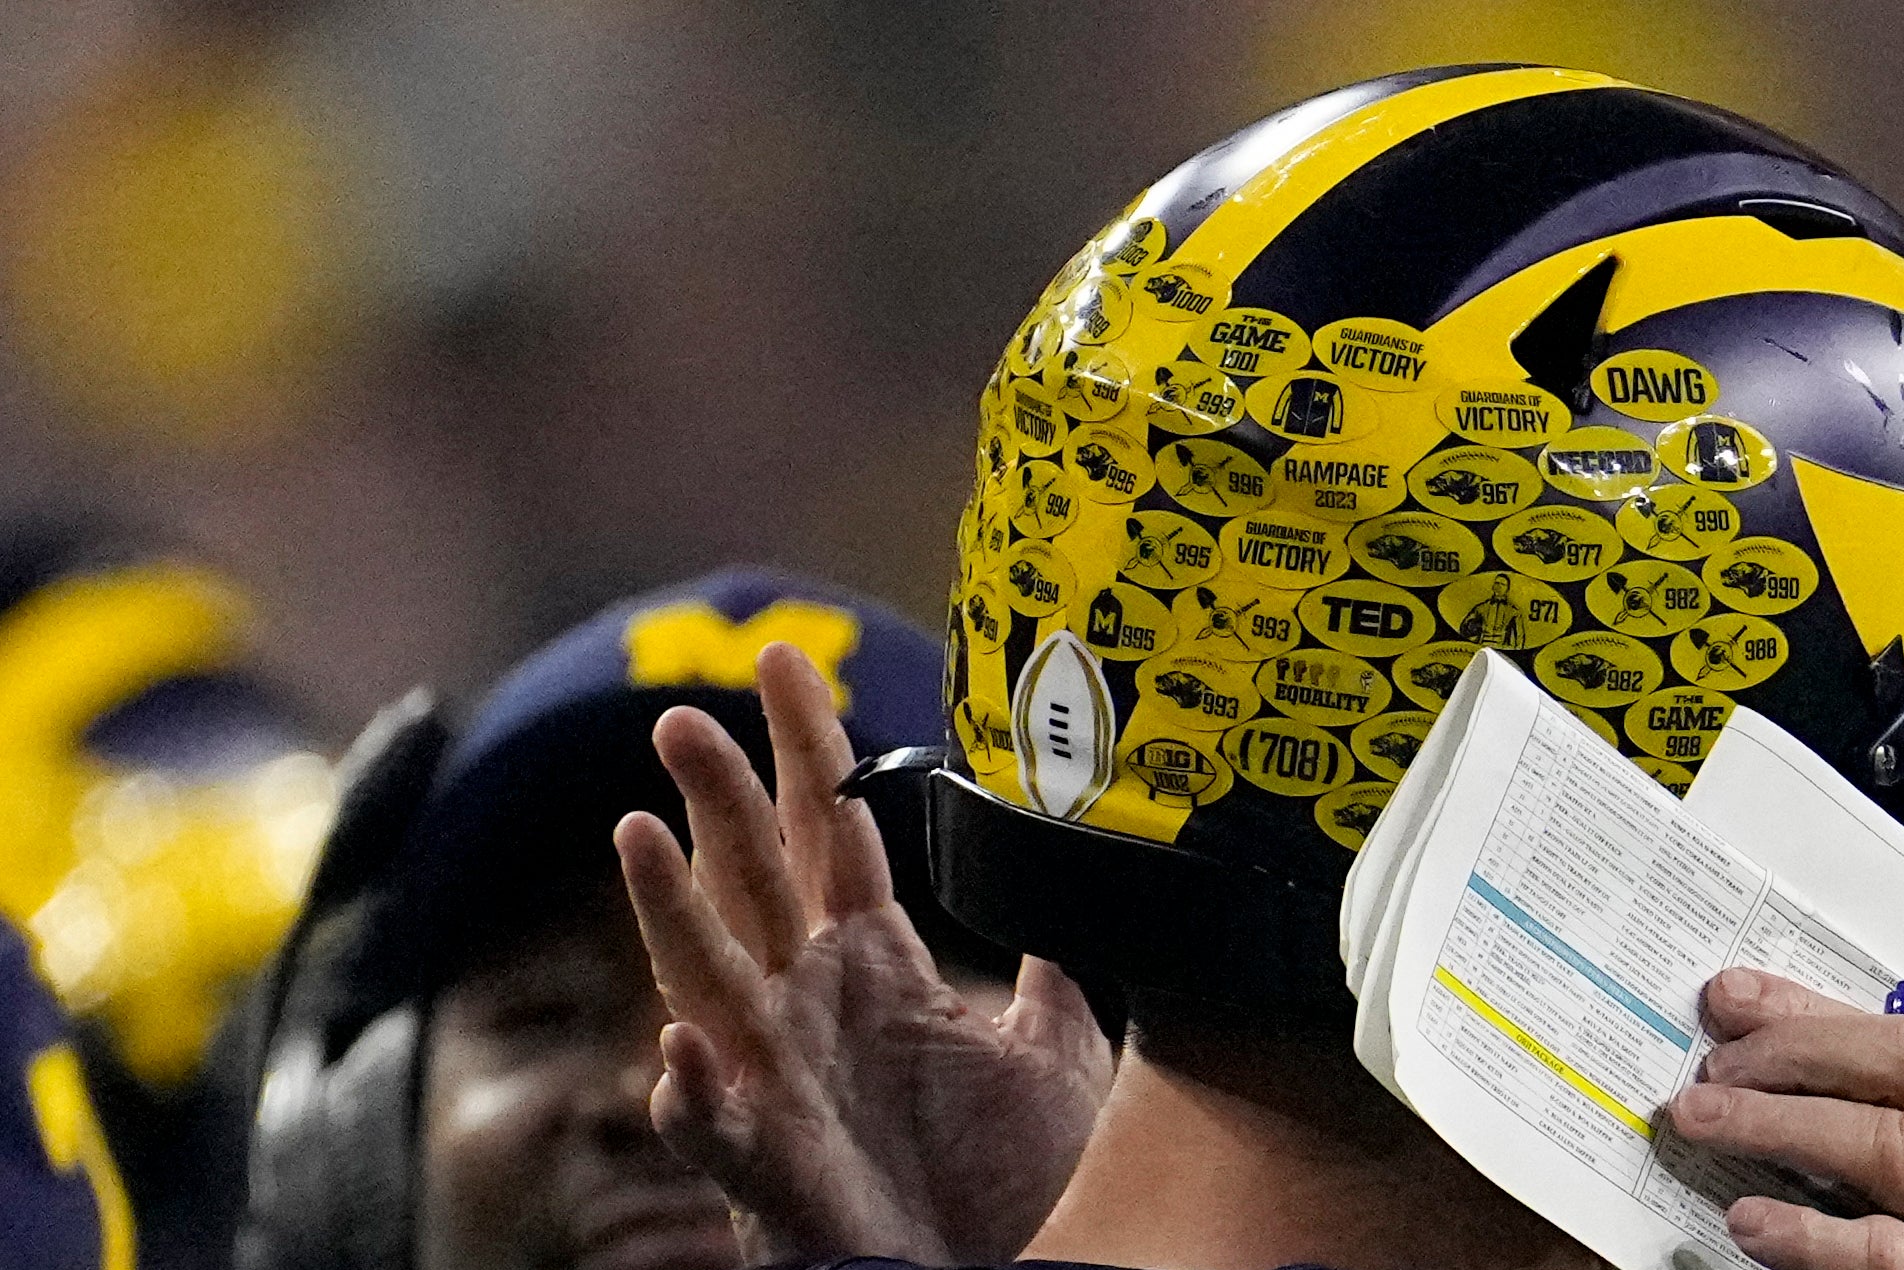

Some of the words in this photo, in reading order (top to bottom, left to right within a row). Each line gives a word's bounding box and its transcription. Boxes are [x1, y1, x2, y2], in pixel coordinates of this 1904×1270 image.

[1171, 291, 1214, 315] 1000
[1242, 315, 1272, 326] THE
[1210, 322, 1291, 353] GAME
[1340, 327, 1408, 351] GUARDIANS
[1409, 341, 1425, 355] OF
[1219, 349, 1260, 373] 1001
[1331, 341, 1427, 382] VICTORY
[1460, 389, 1526, 406] GUARDIANS
[1528, 395, 1542, 407] OF
[1606, 367, 1706, 405] DAWG
[1196, 391, 1236, 417] 999
[1013, 403, 1057, 448] VICTORY
[1455, 406, 1550, 433] VICTORY
[1105, 468, 1138, 495] 996
[1228, 471, 1264, 497] 996
[1285, 458, 1390, 489] RAMPAGE
[1045, 493, 1071, 520] 994
[1315, 489, 1357, 510] 2023
[1481, 482, 1519, 505] 967
[1245, 520, 1312, 543] GUARDIANS
[1312, 531, 1327, 545] OF
[1694, 510, 1730, 532] 990
[1175, 543, 1211, 569] 995
[1238, 537, 1332, 575] VICTORY
[1567, 543, 1602, 566] 977
[1034, 580, 1060, 605] 994
[1665, 587, 1700, 610] 982
[1767, 576, 1800, 600] 990
[1321, 595, 1414, 639] TED
[1528, 599, 1559, 624] 971
[1121, 624, 1156, 652] 995
[1251, 614, 1291, 642] 993
[1744, 637, 1777, 661] 988
[1606, 670, 1644, 693] 982
[1202, 692, 1240, 720] 993
[1273, 682, 1371, 714] EQUALITY
[1673, 695, 1704, 704] THE
[1648, 706, 1724, 731] GAME
[1239, 728, 1339, 785] (708)
[1665, 735, 1701, 757] 988
